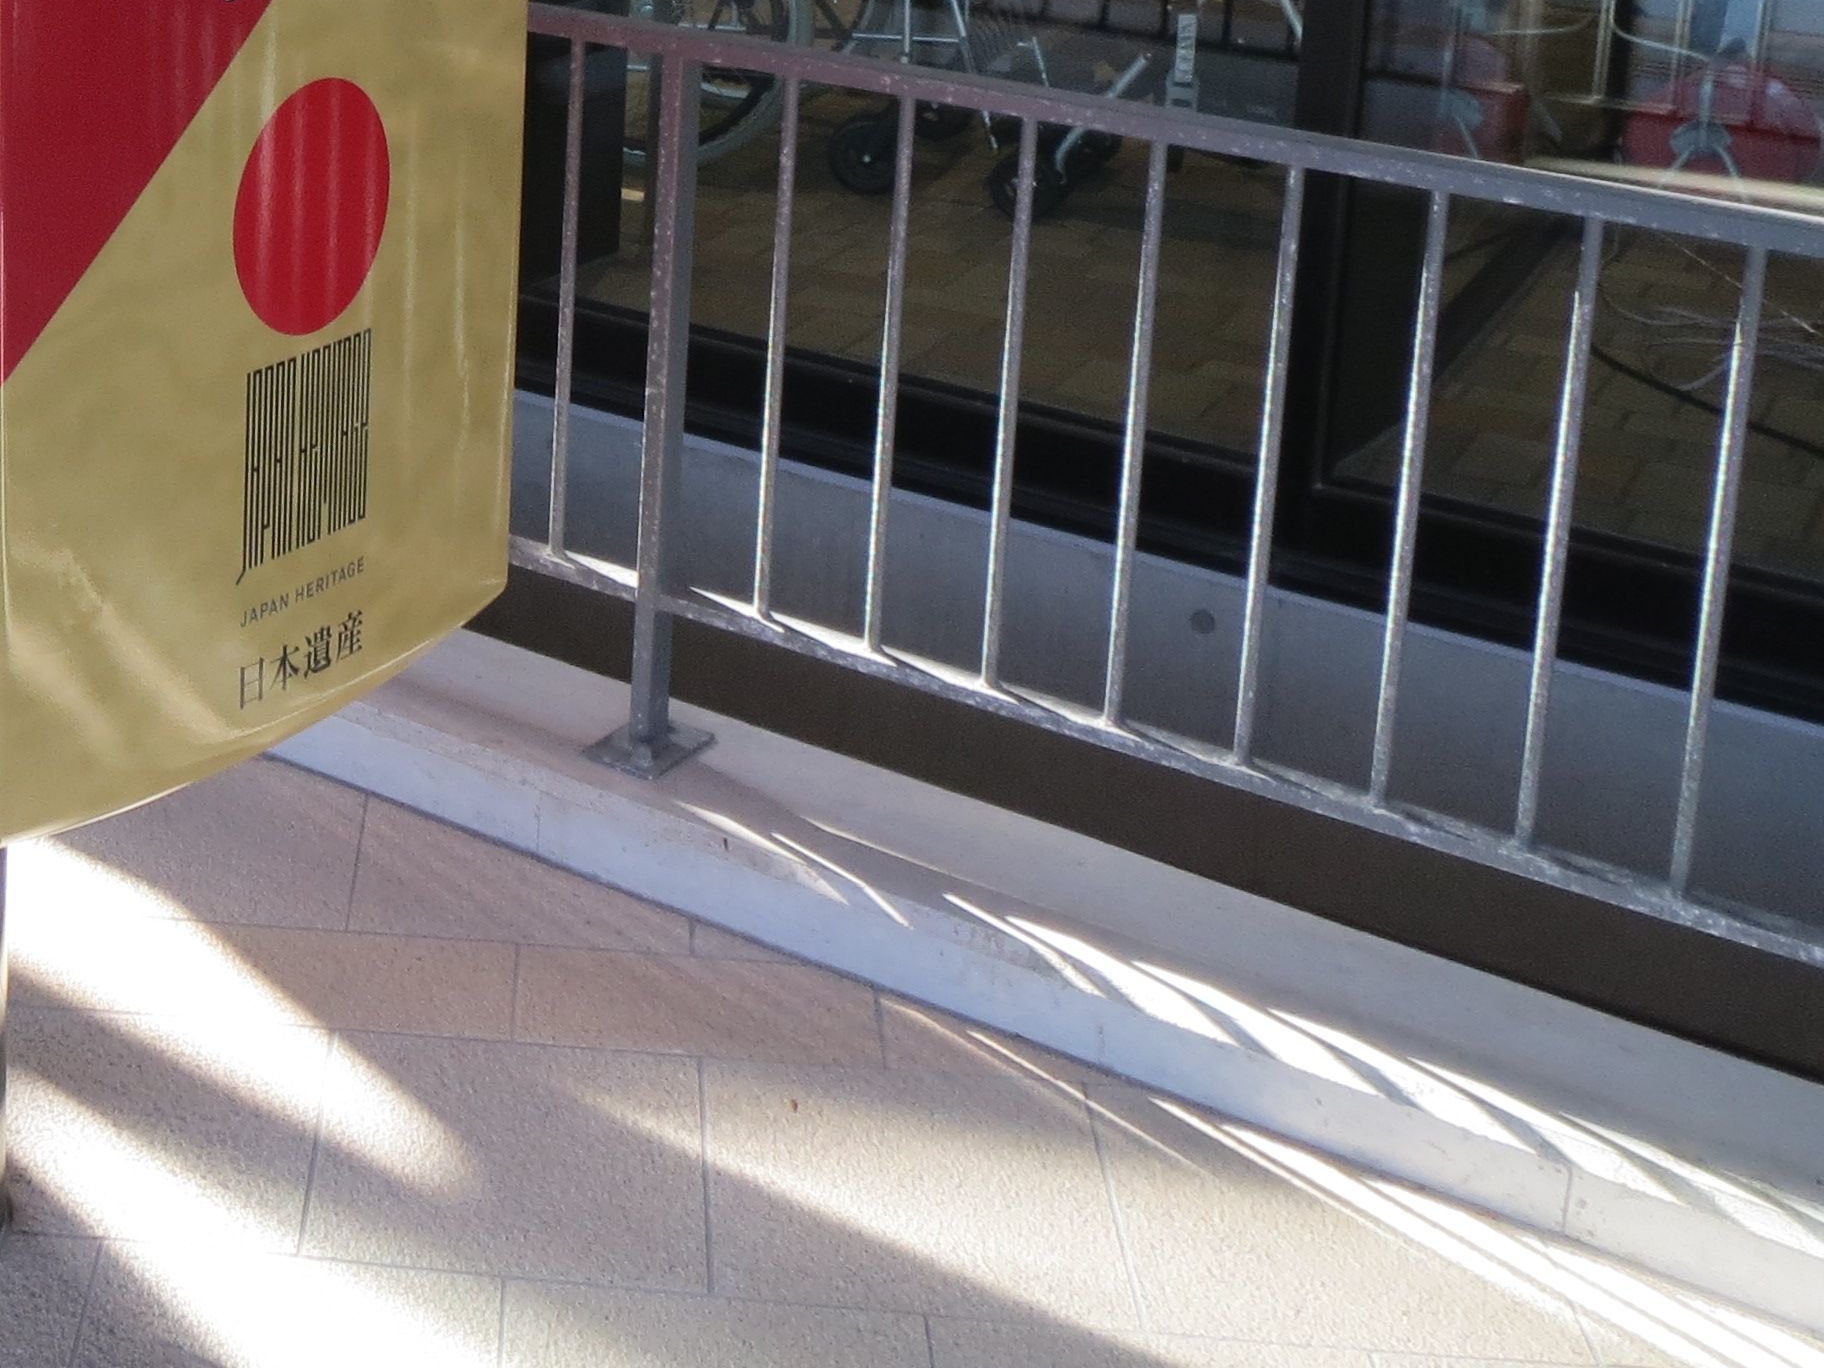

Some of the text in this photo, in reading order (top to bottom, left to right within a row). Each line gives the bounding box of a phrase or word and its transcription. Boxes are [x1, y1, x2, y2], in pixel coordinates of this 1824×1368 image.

[240, 555, 366, 629] JAPAN HERITAGE
[239, 608, 364, 710] 日本遺産
